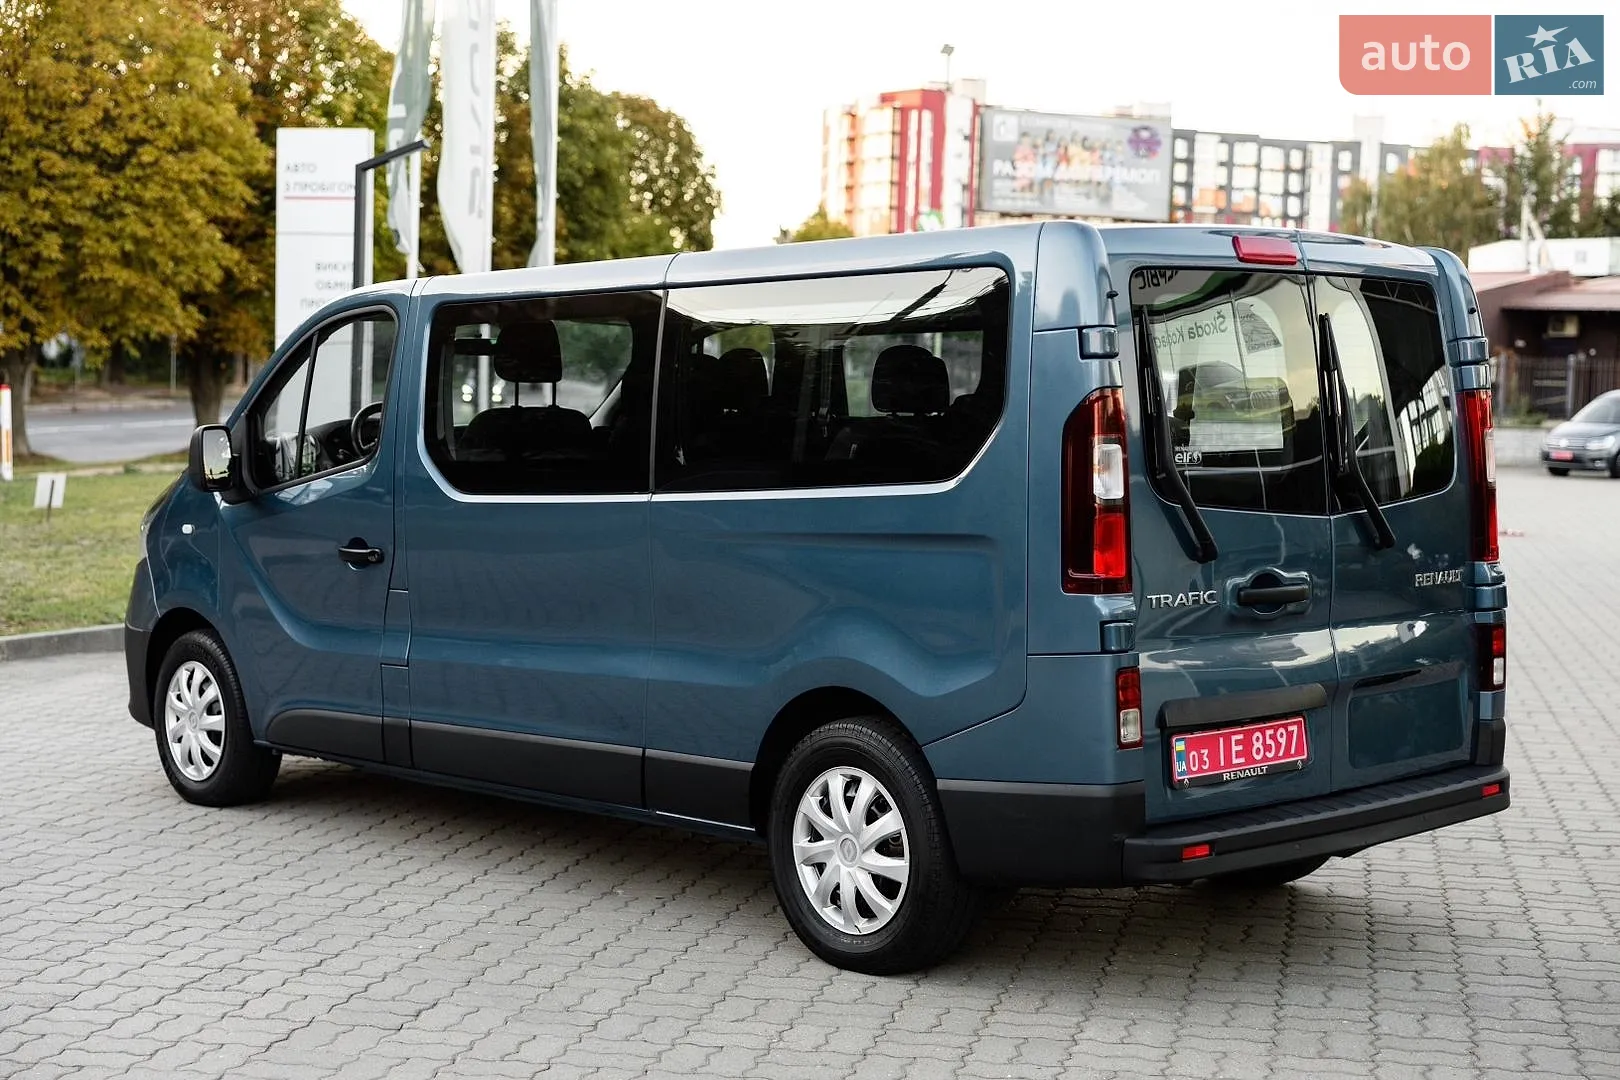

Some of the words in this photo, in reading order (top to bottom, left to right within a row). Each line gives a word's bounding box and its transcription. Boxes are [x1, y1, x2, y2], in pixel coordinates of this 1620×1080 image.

[1174, 451, 1193, 463] elf
[1415, 568, 1464, 587] RENAULT
[1146, 590, 1218, 609] TRAFIC
[1189, 748, 1210, 772] 03
[1219, 734, 1246, 767] IE
[1251, 725, 1298, 761] 8597
[1176, 760, 1187, 773] UA
[1222, 765, 1268, 781] RENAULT
